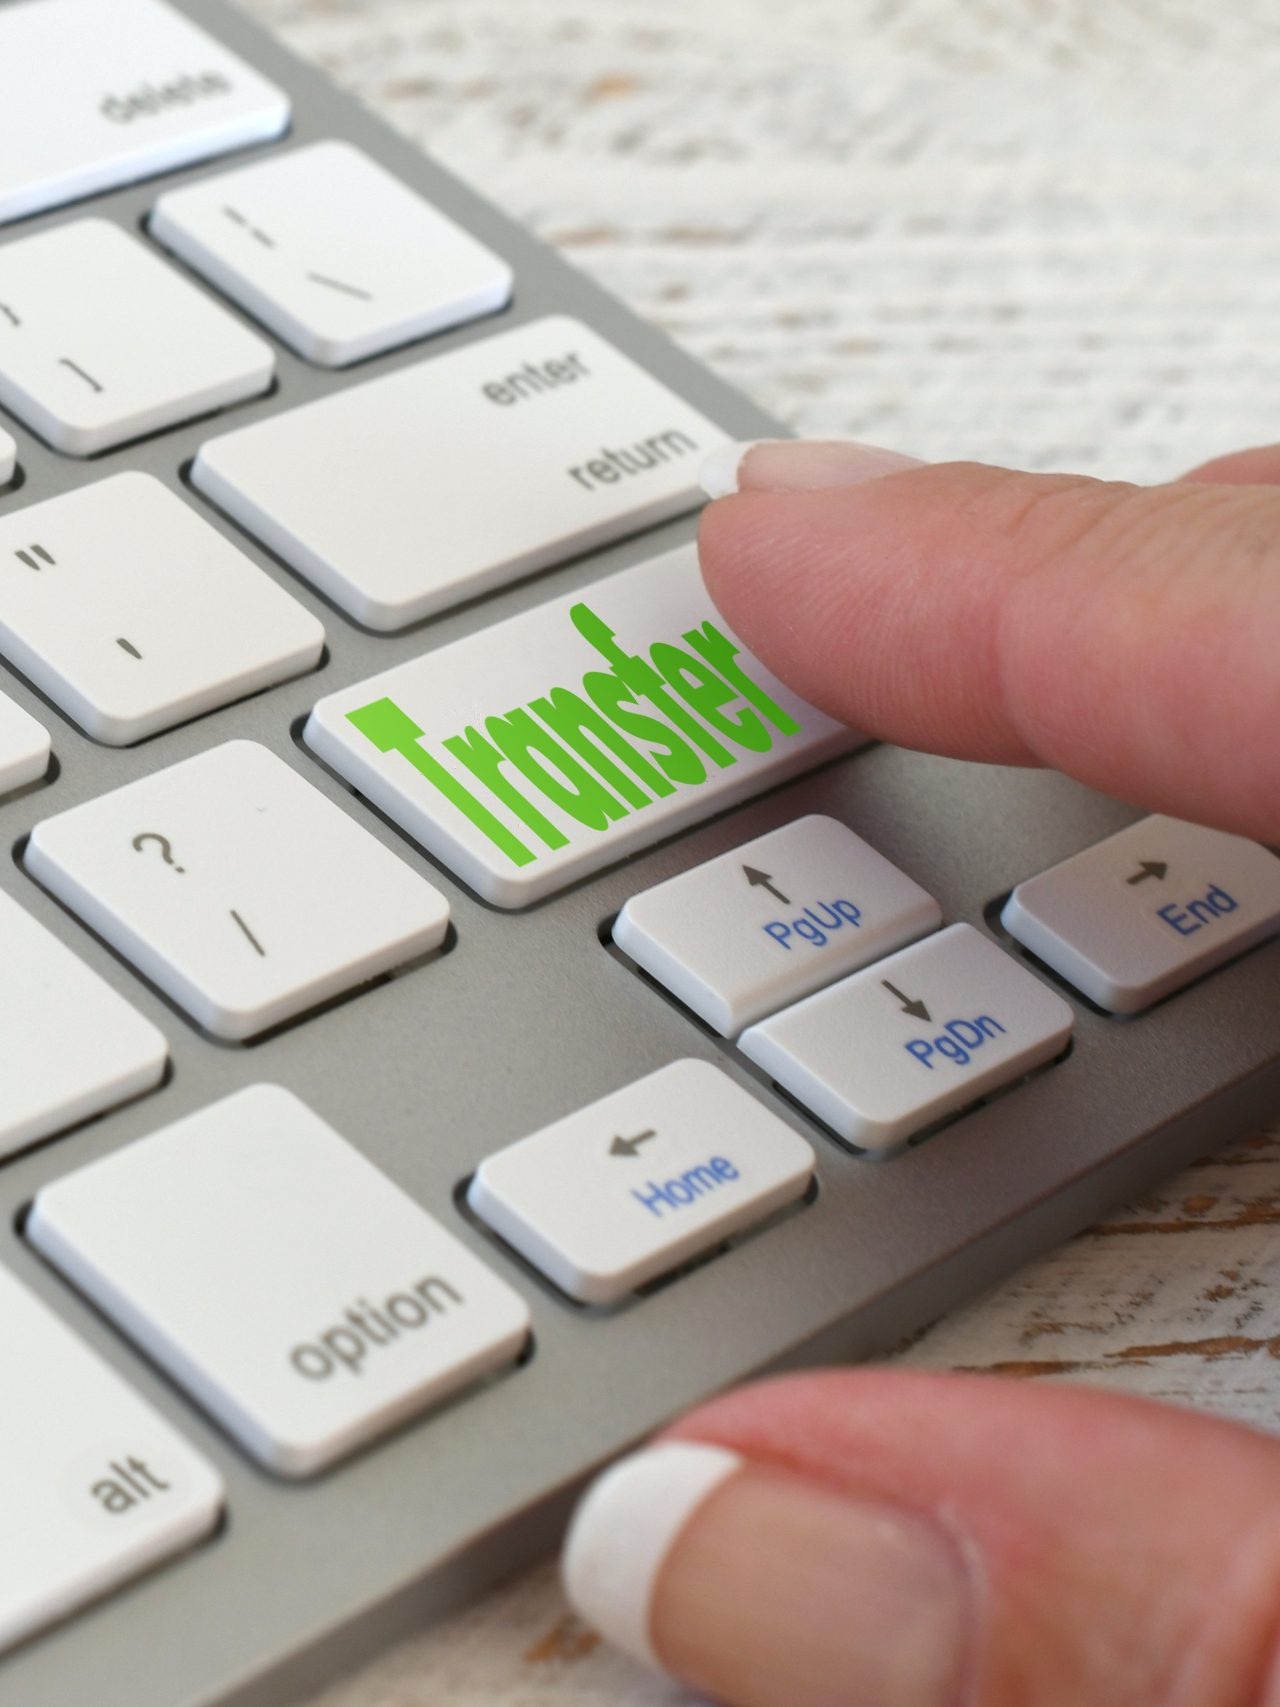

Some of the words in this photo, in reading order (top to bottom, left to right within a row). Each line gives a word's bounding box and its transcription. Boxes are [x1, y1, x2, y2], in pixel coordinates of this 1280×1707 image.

[99, 70, 233, 124] delete
[482, 353, 587, 406] enter
[568, 431, 696, 491] return
[345, 603, 800, 867] Transfer
[763, 899, 862, 950] PgUp
[1157, 885, 1239, 937] End
[904, 1014, 1007, 1070] PgDn
[630, 1156, 740, 1218] Home
[291, 1277, 462, 1380] option
[91, 1457, 169, 1514] alt
